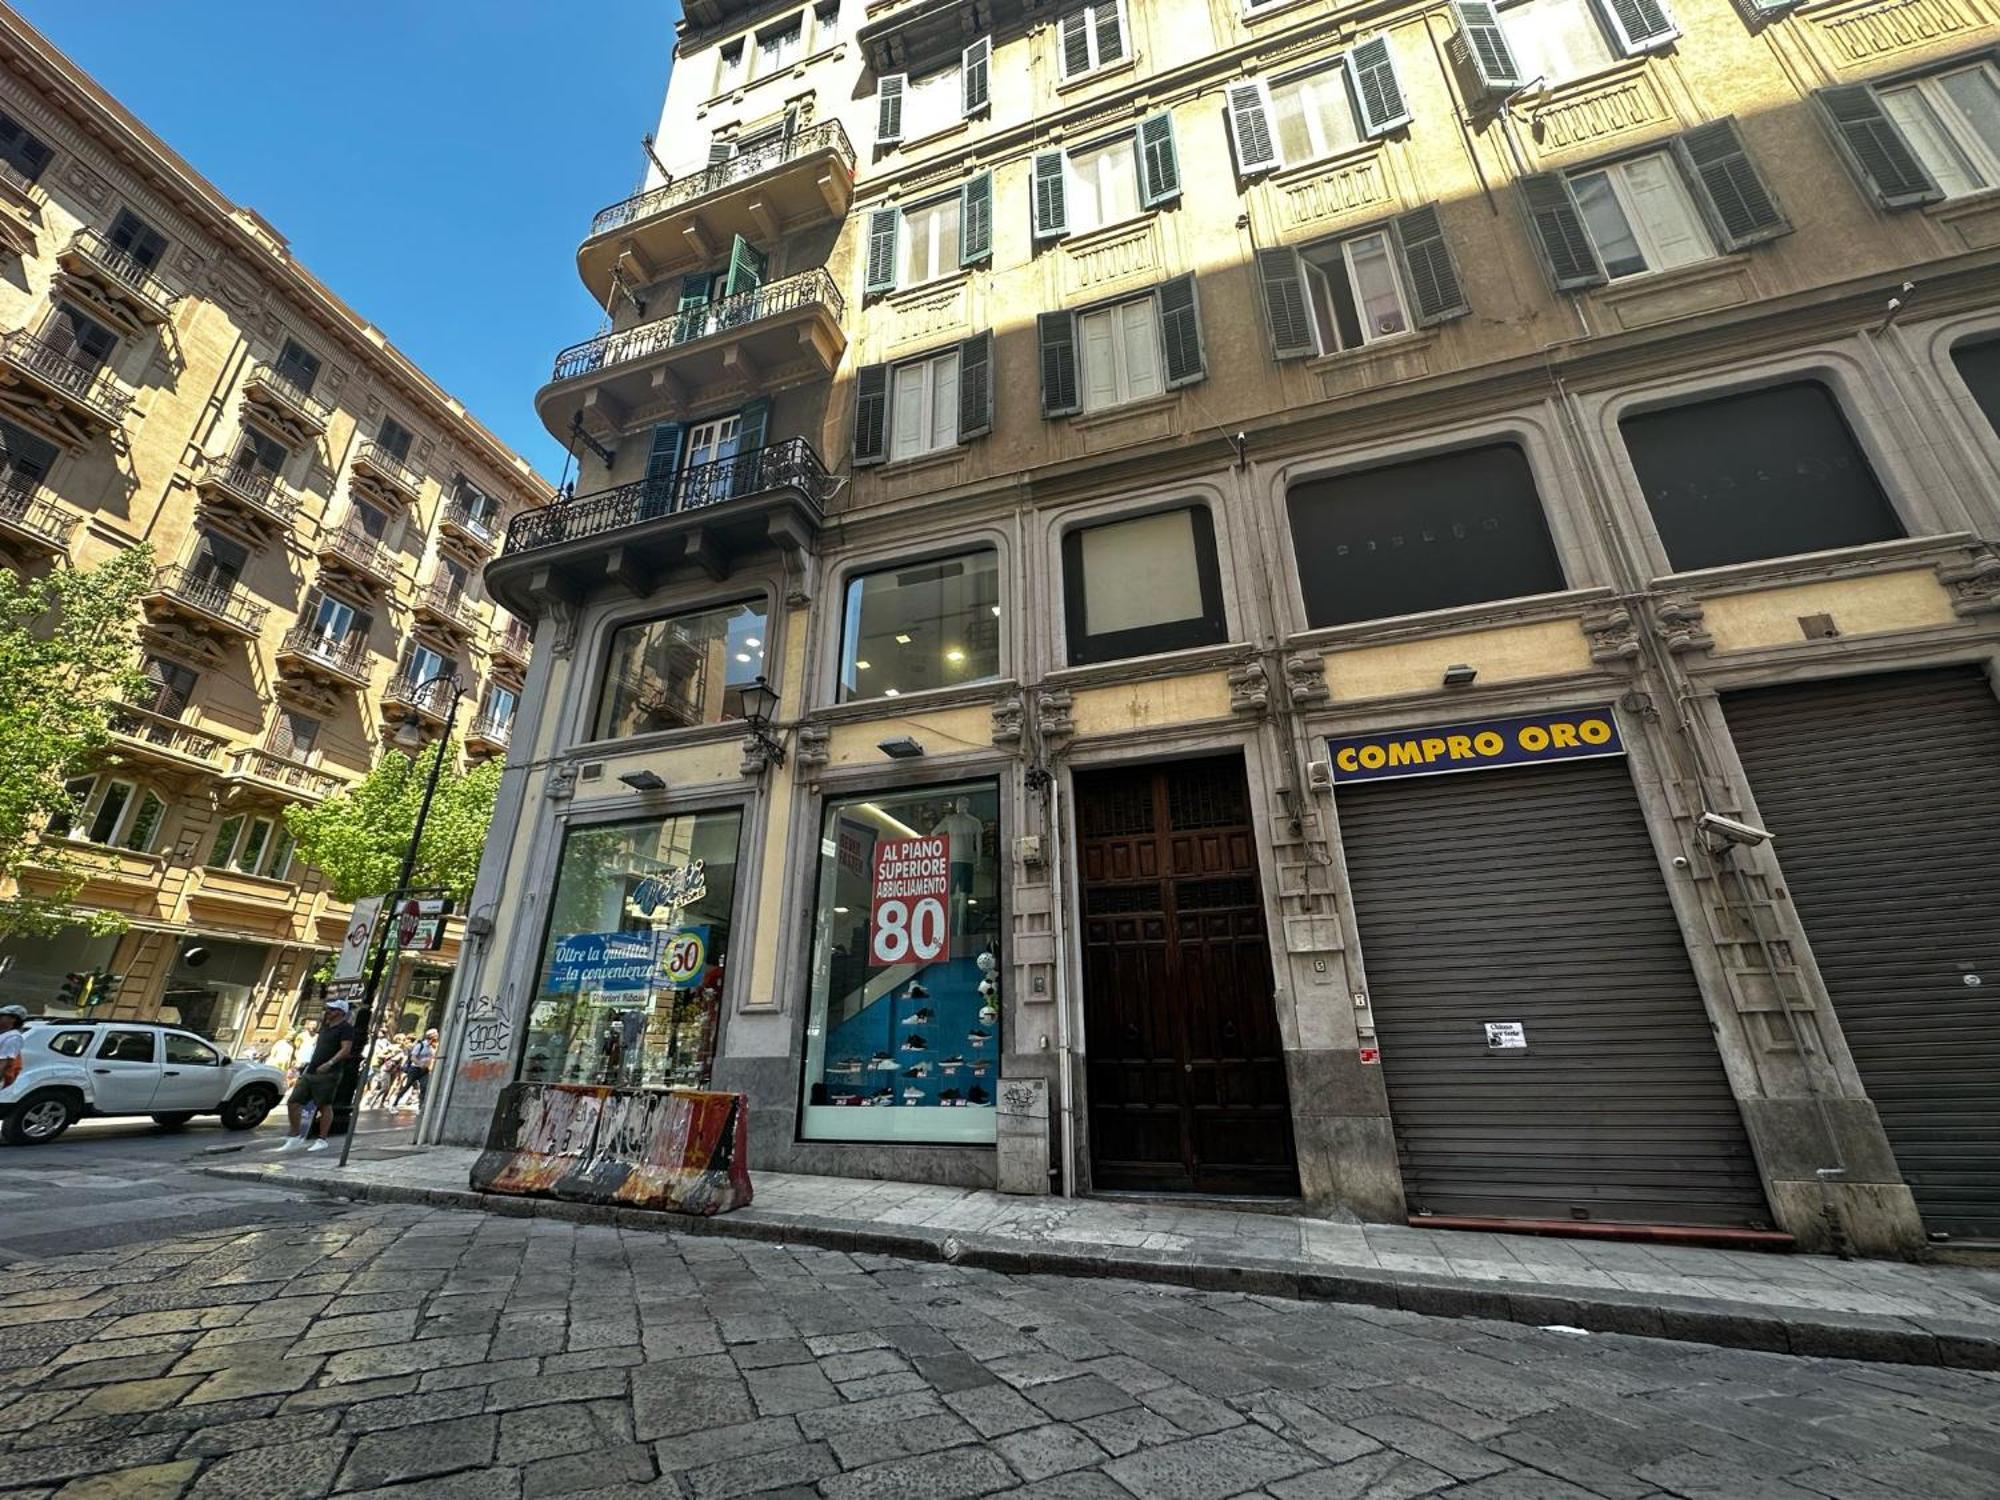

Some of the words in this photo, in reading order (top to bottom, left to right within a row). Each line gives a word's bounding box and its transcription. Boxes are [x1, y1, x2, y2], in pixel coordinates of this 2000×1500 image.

[1336, 730, 1505, 772] COMPRO
[1517, 719, 1612, 752] ORO
[882, 844, 898, 862] AL
[901, 839, 943, 860] PIANO
[878, 857, 947, 880] SUPERIORE
[875, 876, 947, 899] ABBIGLIAMENTO
[874, 897, 945, 962] 80
[555, 946, 584, 963] Oltre
[586, 946, 599, 962] la
[669, 941, 700, 973] 50
